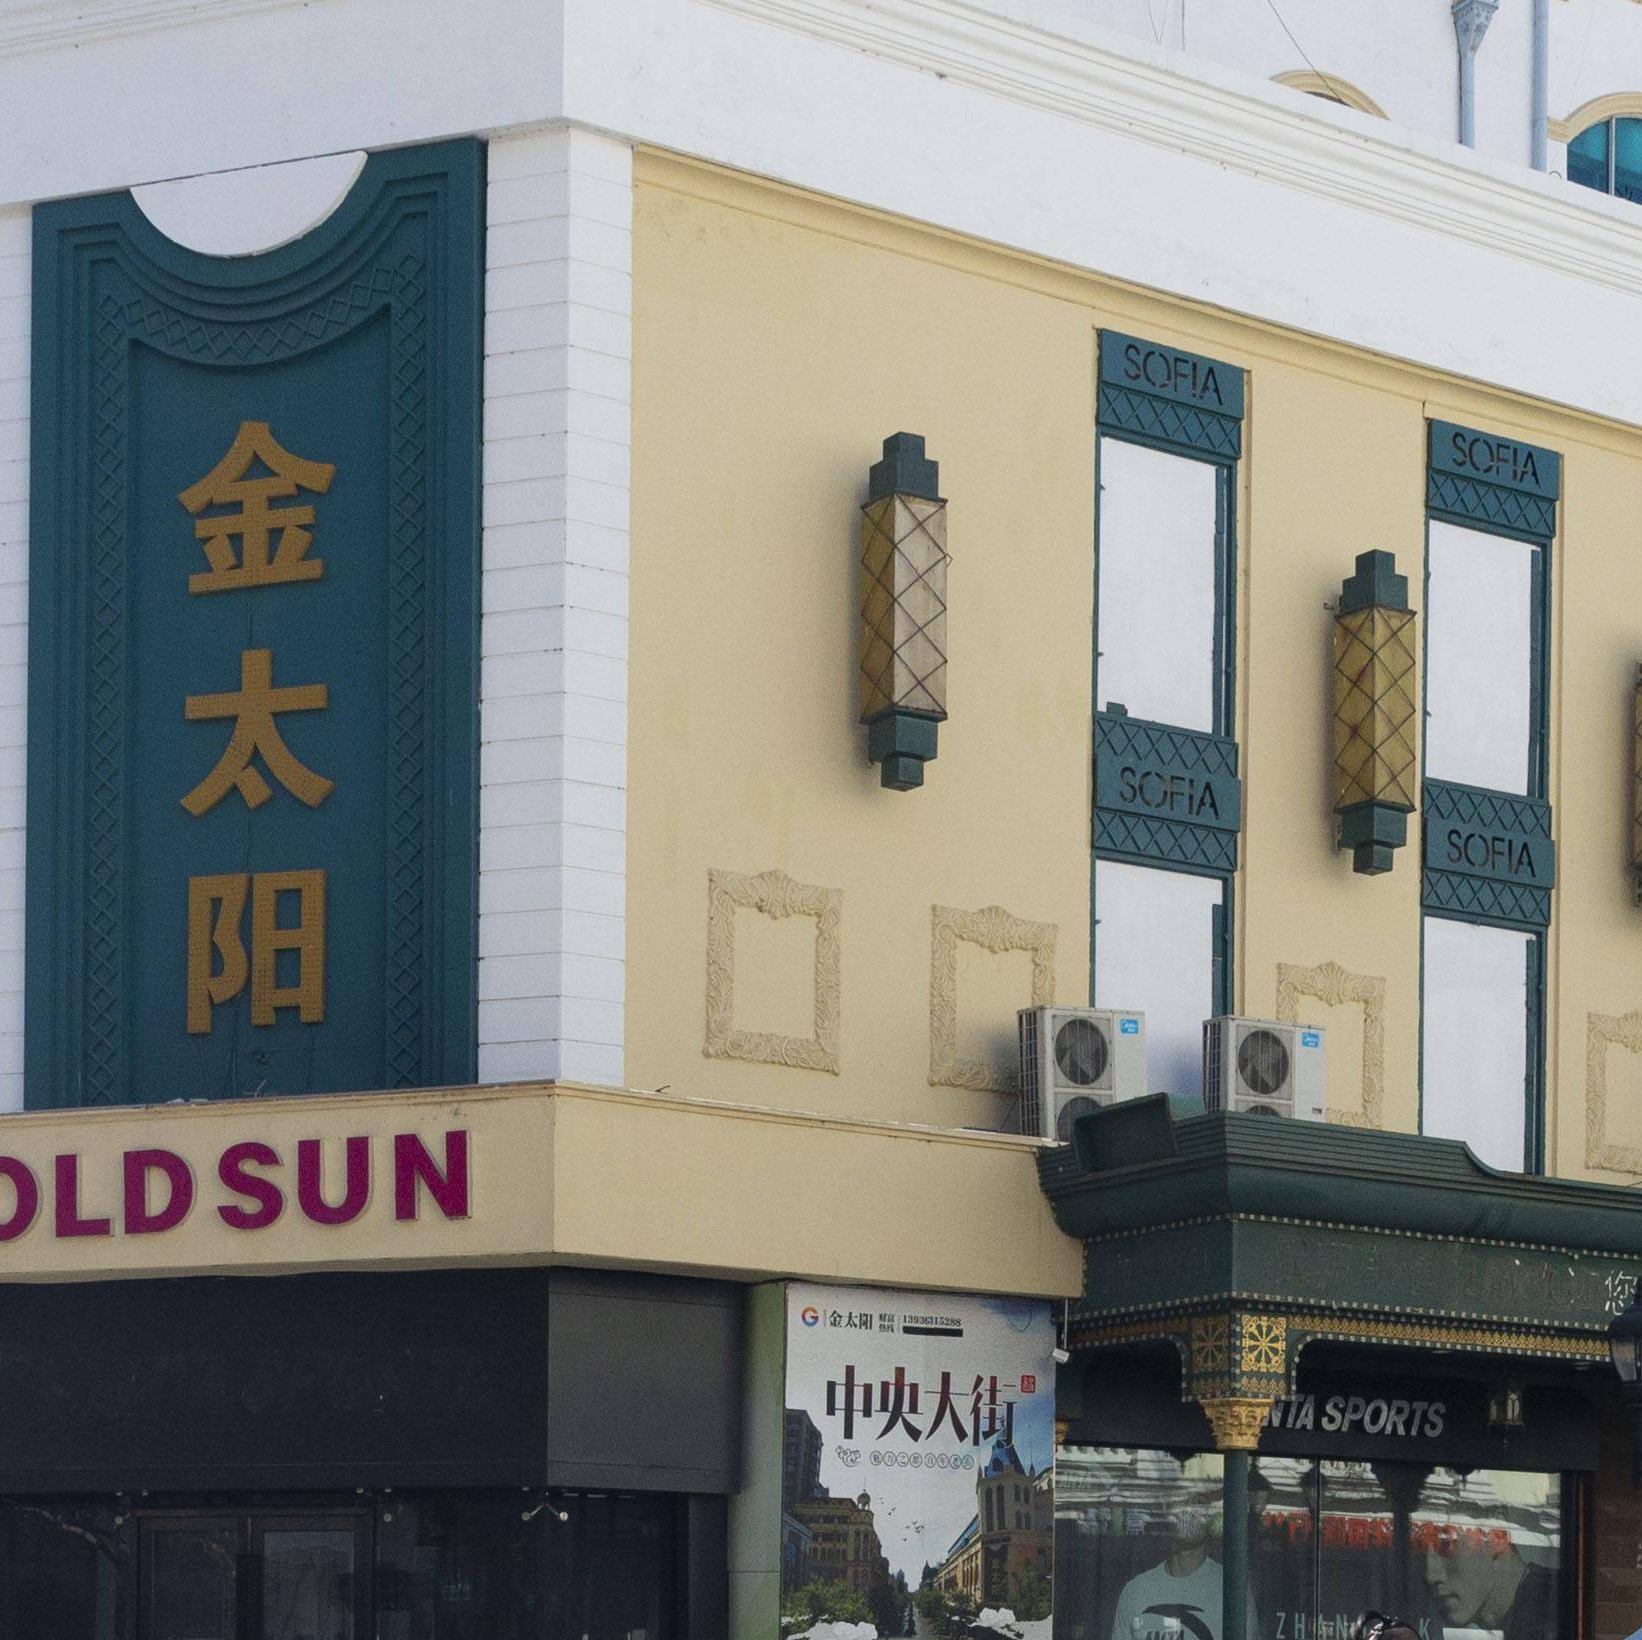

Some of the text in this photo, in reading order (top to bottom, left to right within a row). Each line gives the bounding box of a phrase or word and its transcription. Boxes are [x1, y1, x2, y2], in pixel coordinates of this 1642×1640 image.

[1124, 344, 1224, 405] SOFIA
[1451, 431, 1540, 488] SOFIA
[178, 420, 337, 1034] 金太阳
[1118, 766, 1220, 820] SOFIA
[1446, 829, 1536, 878] SOFIA
[828, 1309, 873, 1330] 金太阳
[826, 1364, 1018, 1447] 中央大街
[1261, 1393, 1446, 1438] NTA SPORTS
